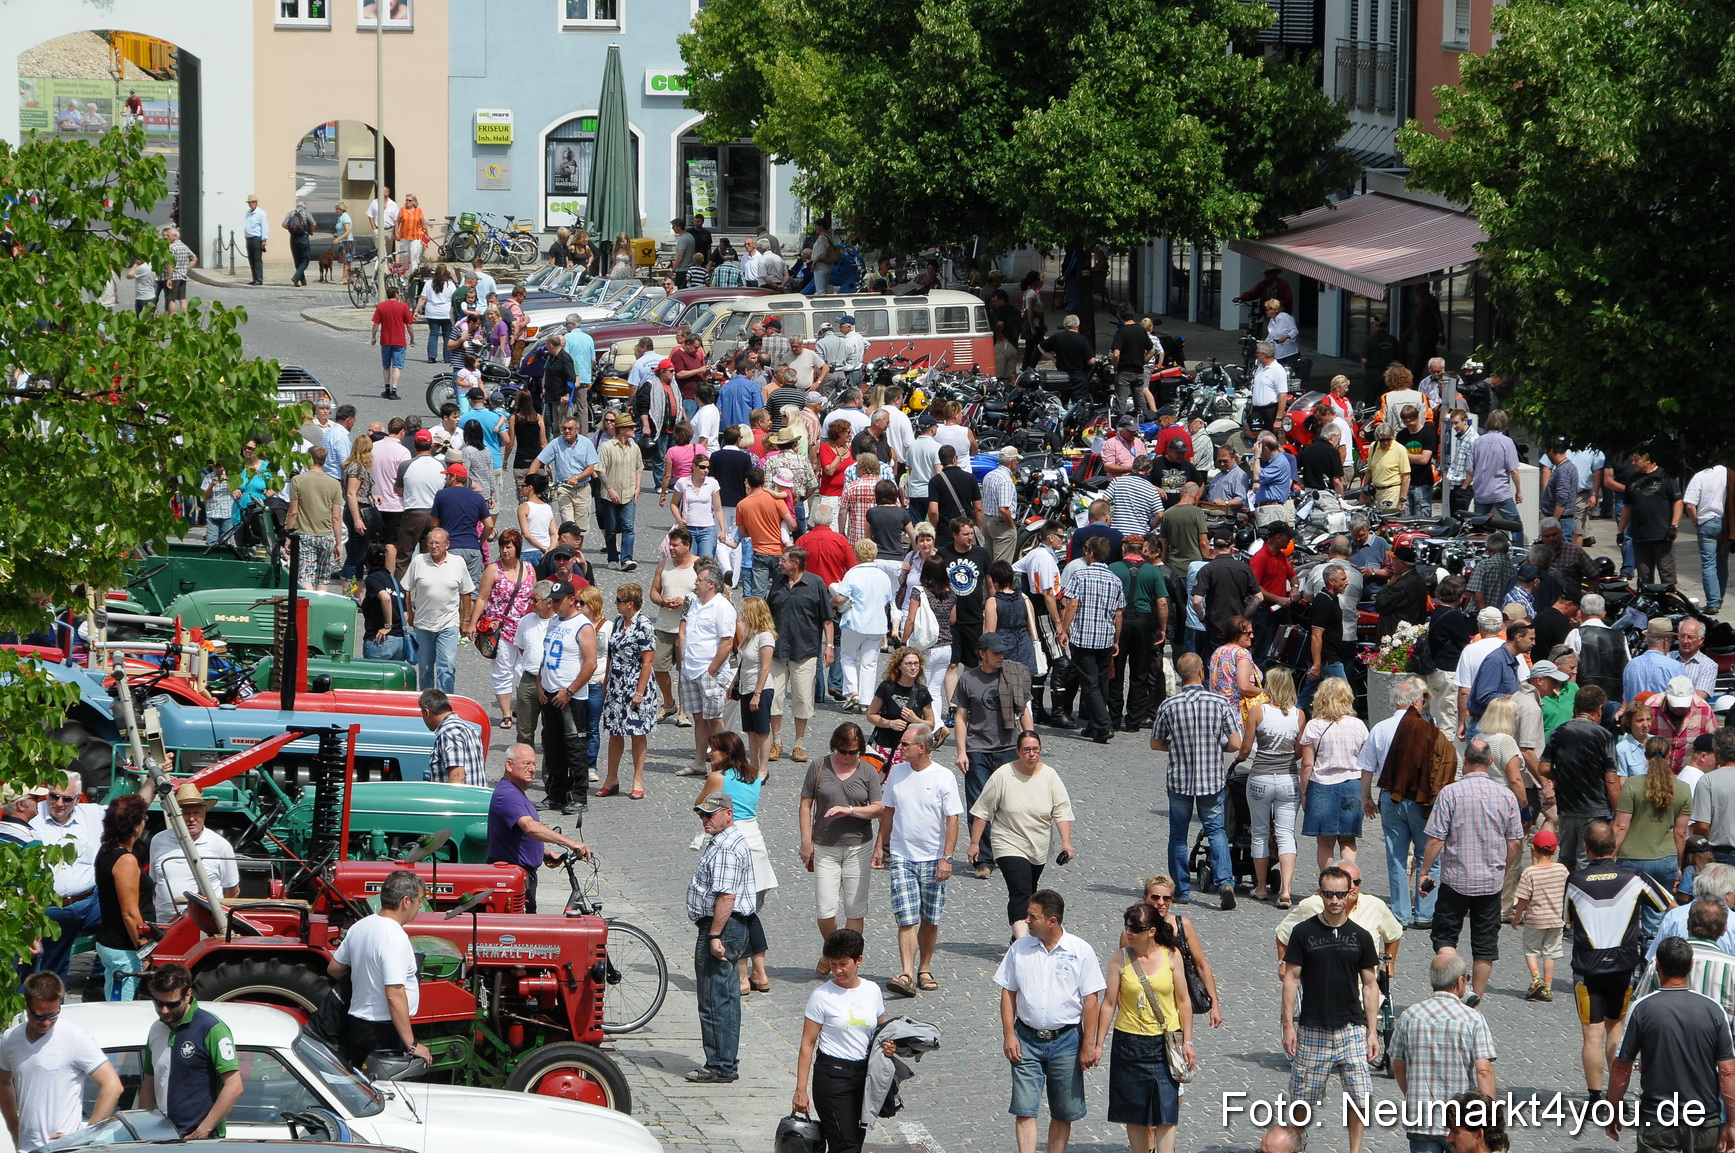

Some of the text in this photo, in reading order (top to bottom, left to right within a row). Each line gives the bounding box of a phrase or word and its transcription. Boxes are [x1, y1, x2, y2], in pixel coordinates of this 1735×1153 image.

[478, 125, 510, 133] FRISEUR
[550, 200, 580, 213] cut
[192, 744, 262, 780] Kramer
